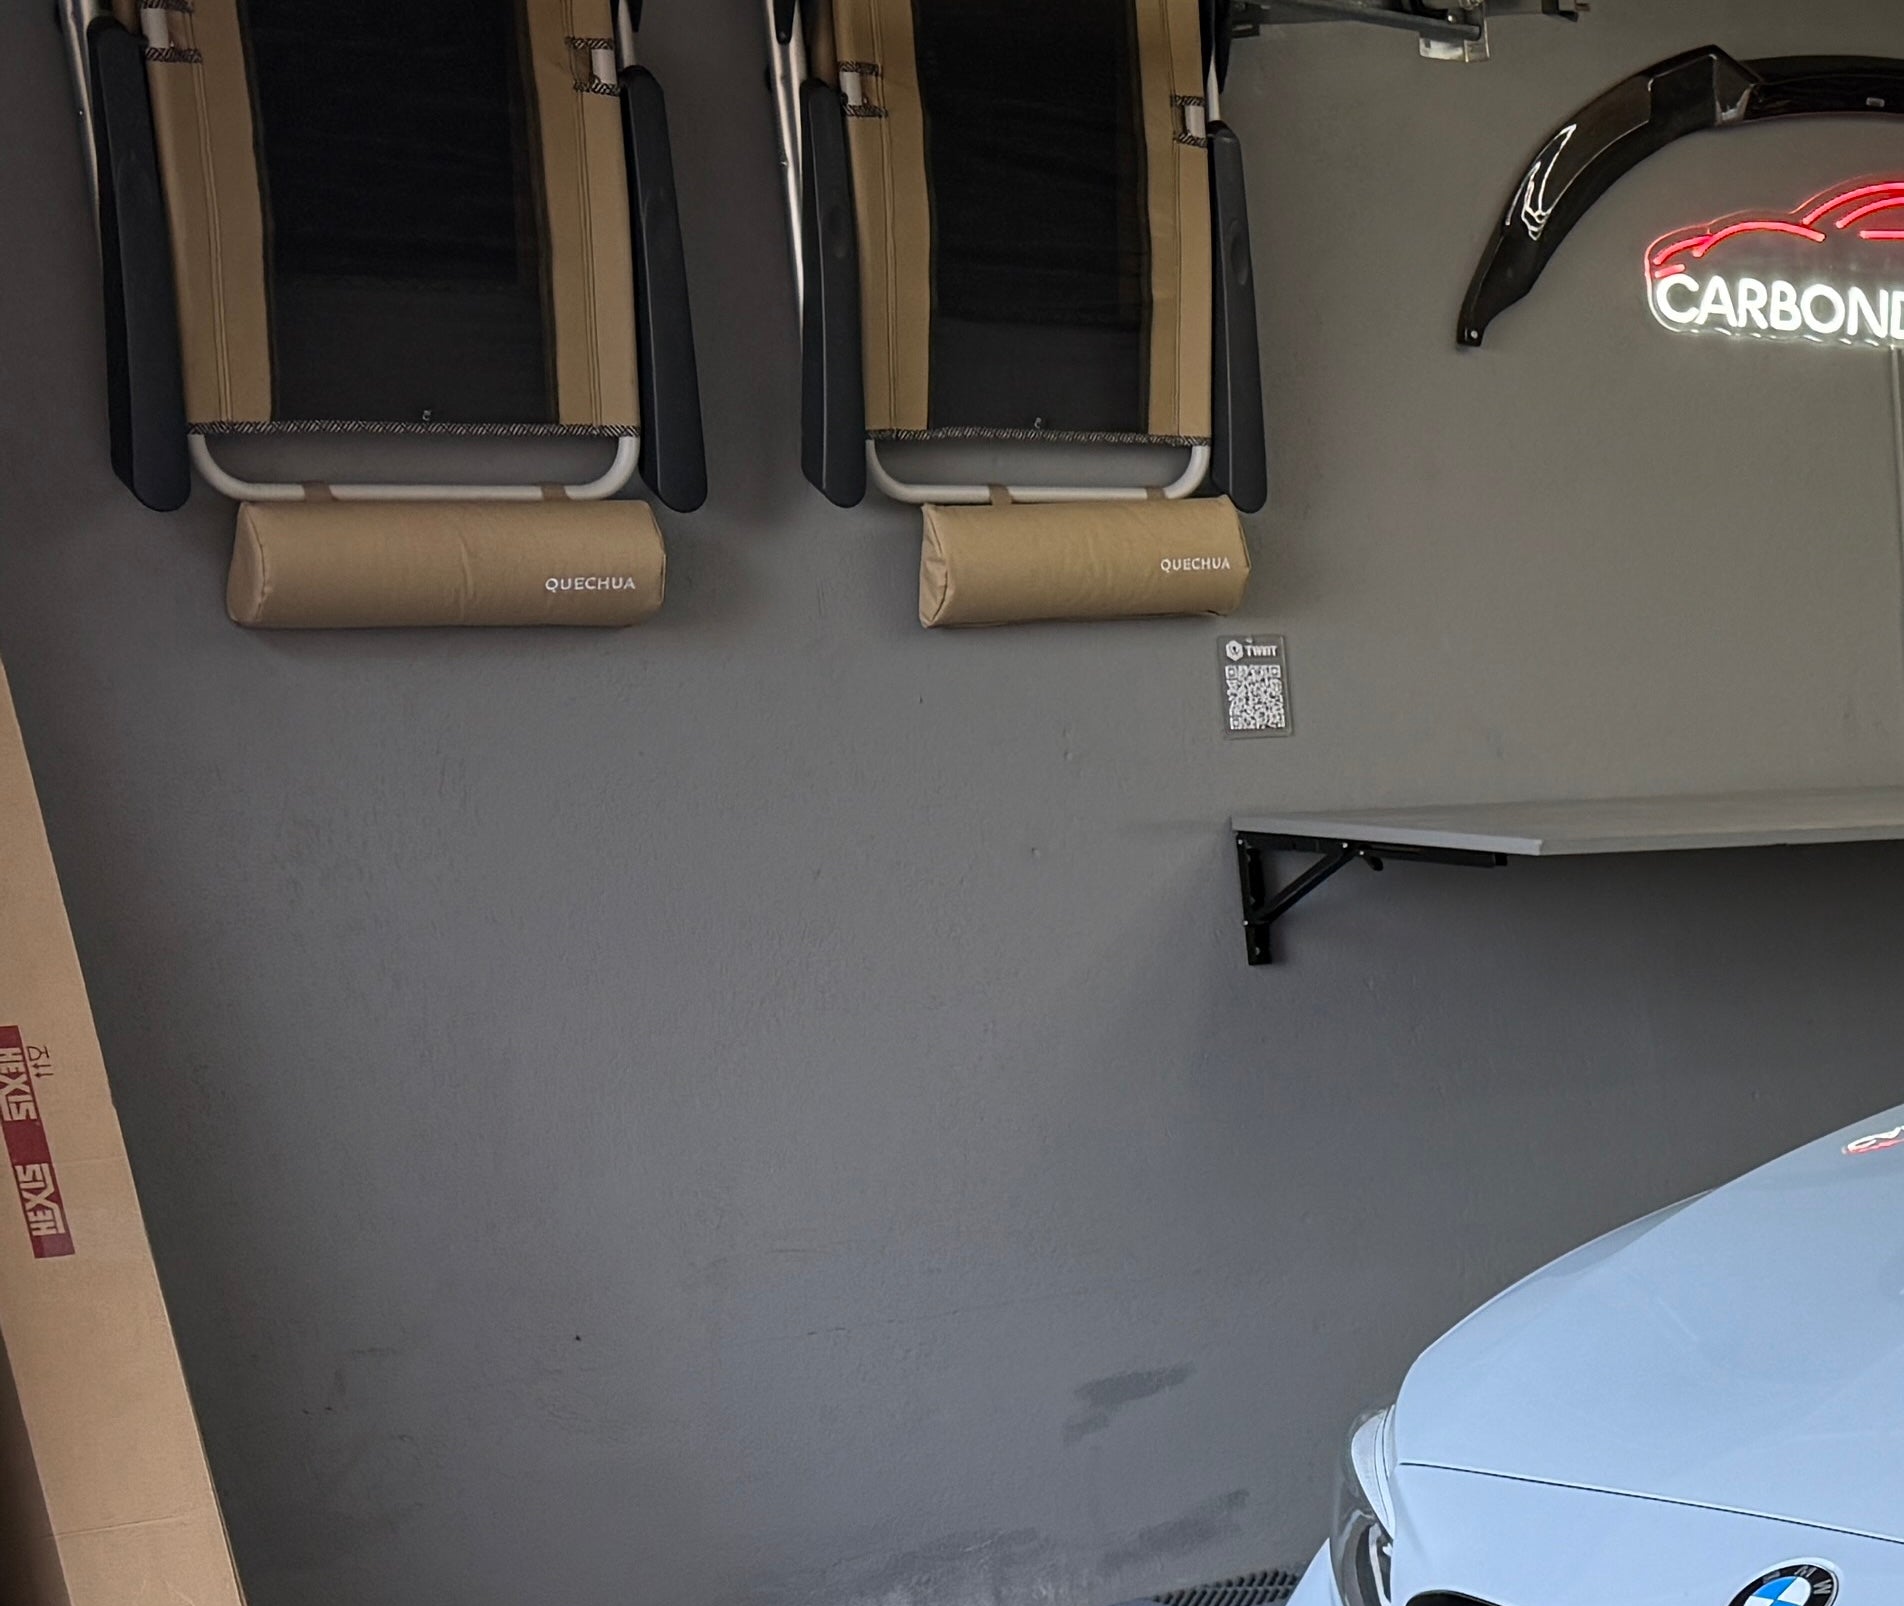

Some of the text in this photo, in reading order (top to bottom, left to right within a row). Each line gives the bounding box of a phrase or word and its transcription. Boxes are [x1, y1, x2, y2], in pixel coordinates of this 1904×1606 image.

[1160, 556, 1231, 573] QUECHUA
[545, 577, 636, 593] QUECHUA
[15, 1162, 66, 1237] HEXIS
